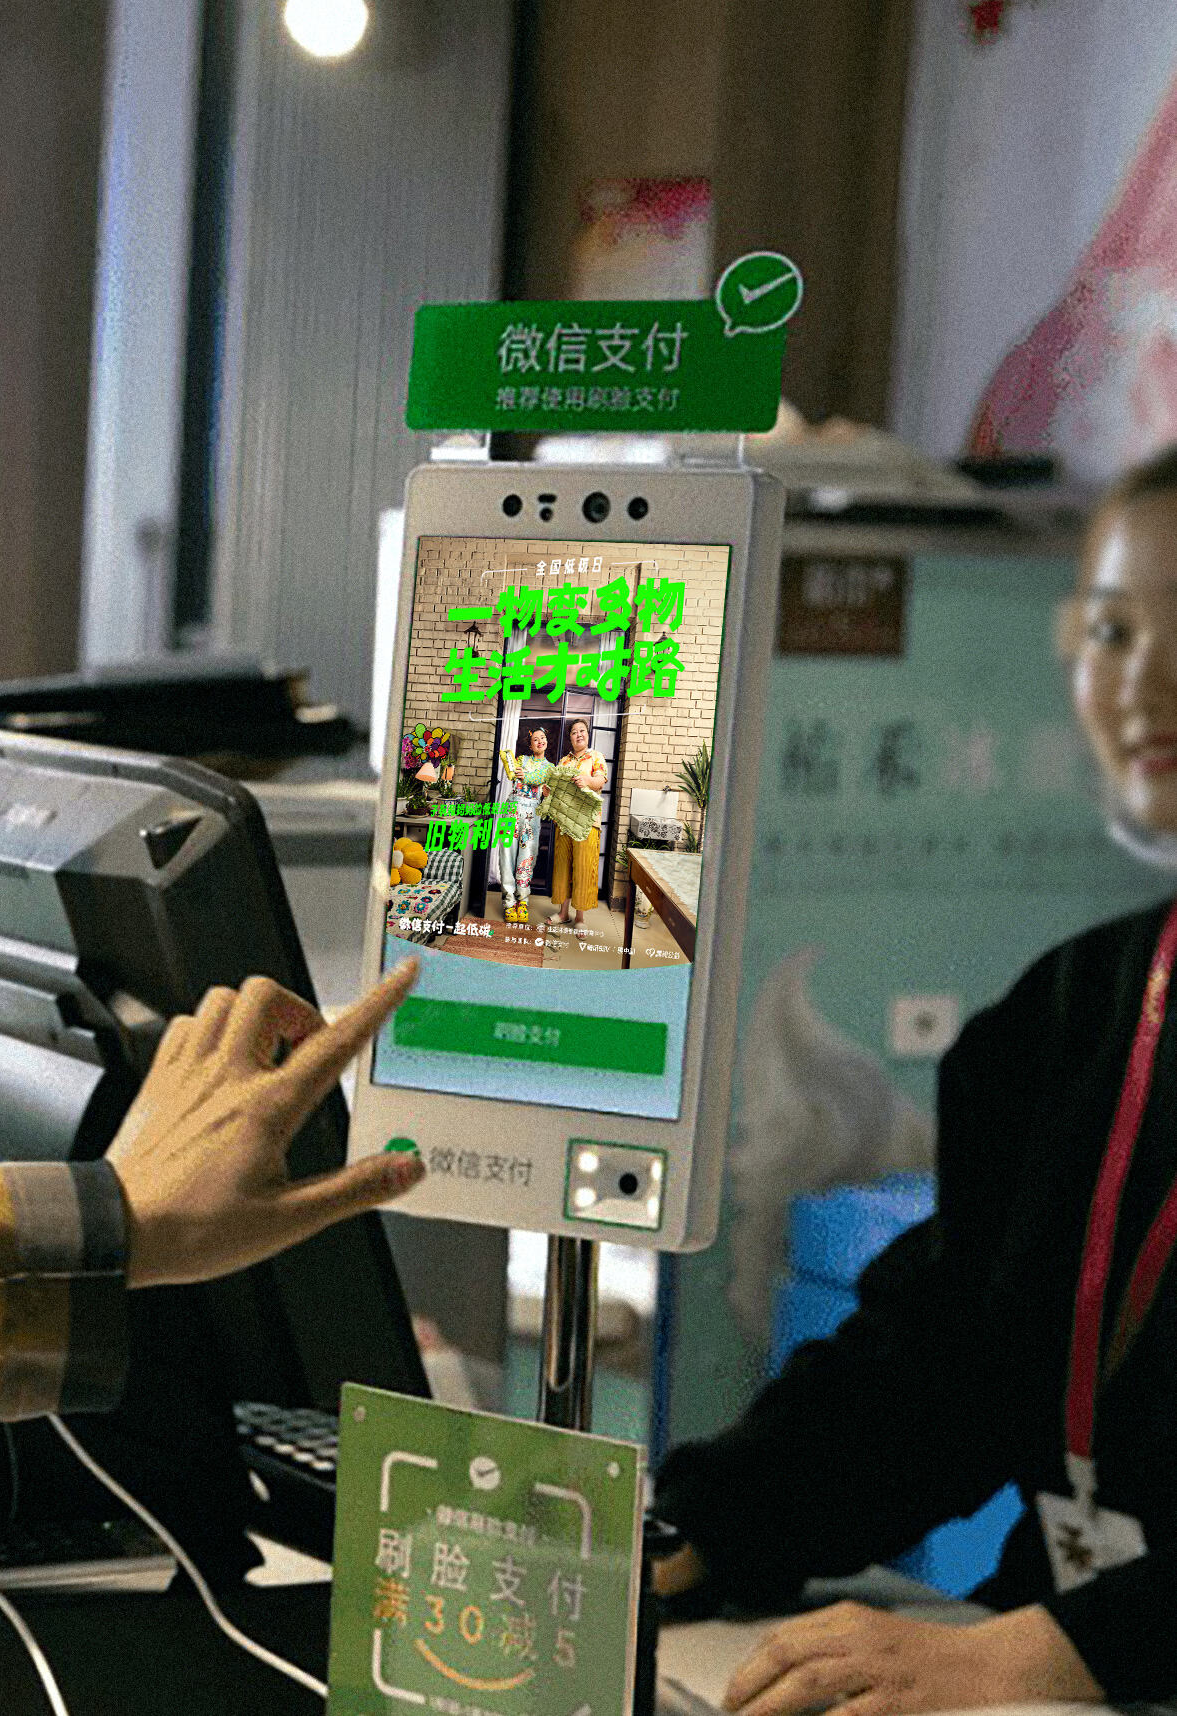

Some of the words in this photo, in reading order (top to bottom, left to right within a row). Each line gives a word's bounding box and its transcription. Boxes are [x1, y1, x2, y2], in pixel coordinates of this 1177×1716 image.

[497, 321, 689, 374] 微信支付
[535, 557, 603, 576] 全国低碳日
[448, 576, 686, 637] 一物变多物
[441, 636, 686, 703] 生活才对路
[424, 817, 517, 852] 旧物利用
[398, 918, 492, 938] 微信支付一起低碳
[428, 1147, 534, 1187] 微信支付
[375, 1528, 587, 1620] 刷脸支付
